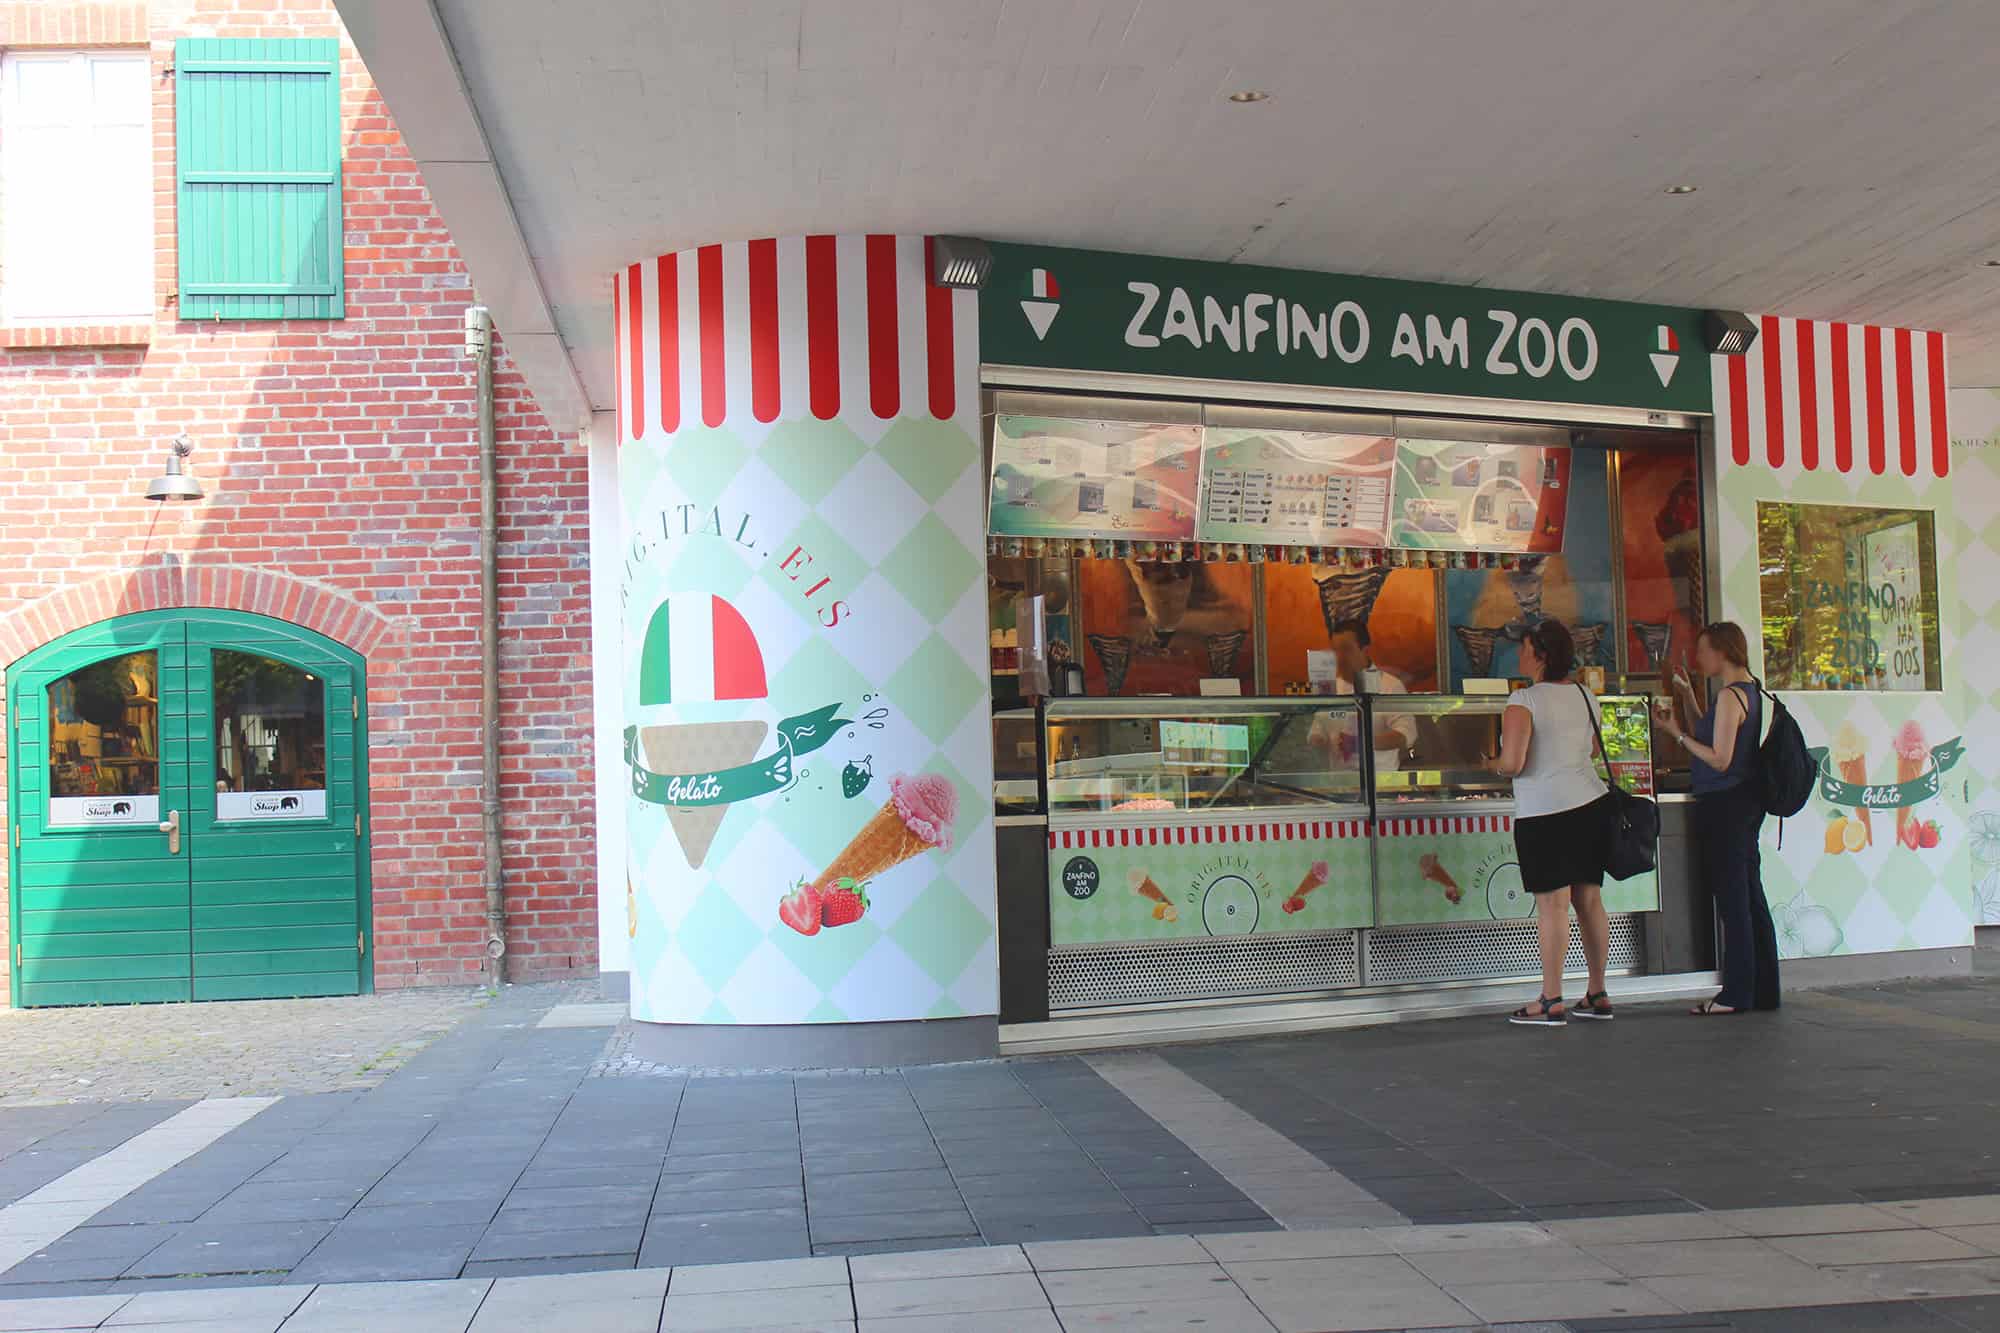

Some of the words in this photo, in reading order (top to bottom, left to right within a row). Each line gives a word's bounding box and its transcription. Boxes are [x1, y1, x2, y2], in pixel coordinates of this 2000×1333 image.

[1124, 281, 1370, 364] ZANFINO
[1391, 312, 1469, 370] AM
[1485, 309, 1599, 382] ZOO
[779, 545, 851, 628] EIS
[1830, 637, 1880, 670] ZOO
[667, 776, 722, 804] Gelato
[1862, 785, 1902, 808] Gelato
[86, 807, 111, 817] Shop
[254, 801, 279, 812] Shop
[1066, 871, 1096, 881] ZANFINO
[1073, 886, 1090, 896] ZOO
